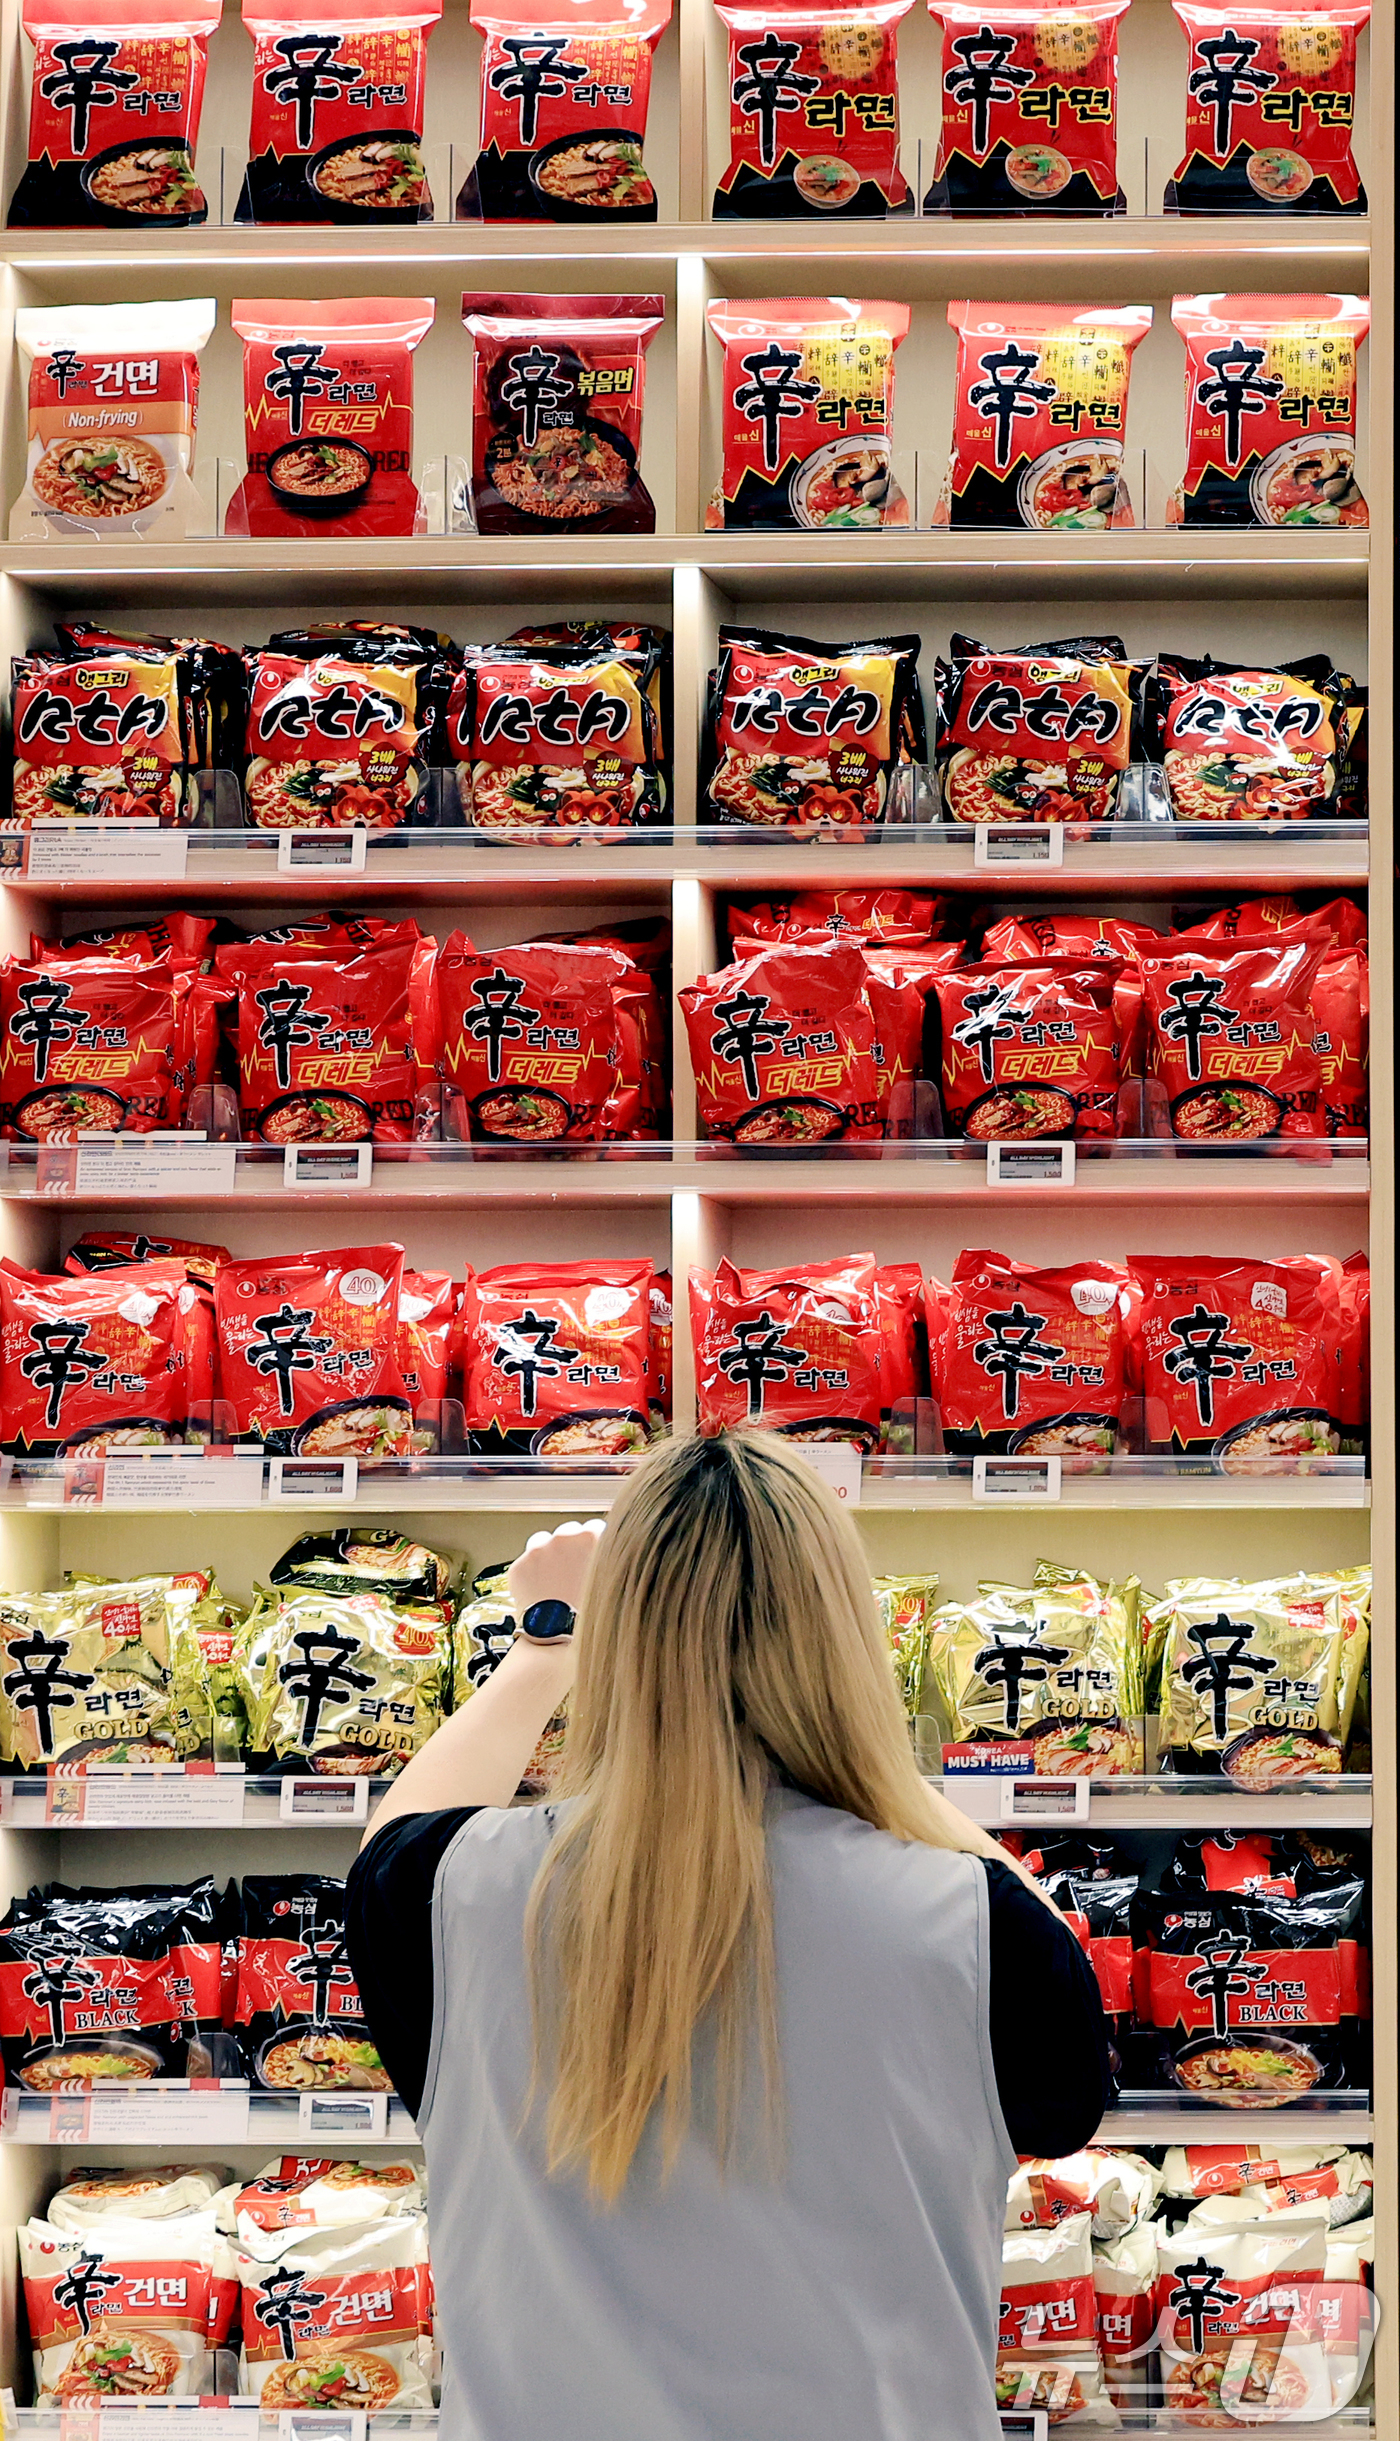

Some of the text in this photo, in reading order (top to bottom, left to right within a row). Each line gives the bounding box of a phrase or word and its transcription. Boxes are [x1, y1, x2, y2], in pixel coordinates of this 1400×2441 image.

[40, 35, 140, 155] 辛
[123, 90, 182, 116] 라면
[263, 32, 365, 149] 辛
[347, 83, 407, 109] 라면
[489, 32, 590, 146] 辛
[571, 83, 632, 108] 라면
[731, 31, 822, 167] 辛
[943, 24, 1036, 155] 辛
[1188, 27, 1279, 157] 辛
[804, 90, 896, 137] 라면
[1018, 83, 1112, 128] 라면
[1260, 87, 1353, 132] 라면
[46, 346, 86, 399] 辛
[90, 360, 159, 397] 건면
[265, 338, 341, 435] 辛
[577, 367, 634, 396] 볶음면
[328, 381, 377, 404] 라면
[501, 345, 574, 447] 辛
[734, 341, 821, 471] 辛
[968, 341, 1058, 468] 辛
[1197, 338, 1284, 466] 辛
[308, 410, 378, 434] 더레드
[542, 410, 574, 426] 라면
[816, 396, 888, 430] 라면
[1050, 400, 1122, 432] 라면
[1278, 394, 1351, 428] 라면
[76, 668, 130, 691] 앵그리
[133, 756, 159, 770] 3배
[369, 750, 396, 765] 3배
[594, 759, 622, 772] 3배
[839, 752, 867, 767] 3배
[1076, 760, 1104, 777] 3배
[9, 975, 91, 1083] 辛
[75, 1026, 129, 1050] 라면
[255, 978, 332, 1089] 辛
[463, 967, 541, 1082] 辛
[526, 1025, 580, 1050] 라면
[1020, 1021, 1077, 1046] 라면
[1159, 971, 1239, 1080] 辛
[1227, 1021, 1281, 1047] 라면
[317, 1027, 373, 1053] 라면
[711, 990, 793, 1101] 辛
[780, 1030, 838, 1059] 라면
[52, 1056, 133, 1082] 더레드
[298, 1058, 374, 1088] 더레드
[506, 1057, 583, 1083] 더레드
[766, 1061, 843, 1096] 더레드
[1000, 1052, 1080, 1080] 더레드
[1207, 1051, 1287, 1079] 더레드
[955, 1322, 986, 1349] 울리는
[21, 1318, 110, 1429] 辛
[245, 1302, 333, 1416] 辛
[322, 1347, 376, 1375] 라면
[491, 1308, 581, 1418] 辛
[718, 1311, 809, 1425] 辛
[973, 1301, 1066, 1419] 辛
[1164, 1303, 1254, 1427] 辛
[1242, 1359, 1297, 1385] 라면
[92, 1371, 148, 1394] 라면
[567, 1364, 622, 1387] 라면
[794, 1368, 850, 1391] 라면
[1050, 1363, 1105, 1386] 라면
[278, 1624, 378, 1749] 辛
[1056, 1669, 1113, 1692] 라면
[1181, 1613, 1277, 1742] 辛
[1264, 1678, 1321, 1703] 라면
[4, 1630, 95, 1755] 辛
[84, 1689, 144, 1715] 라면
[358, 1697, 415, 1725] 라면
[1042, 1698, 1115, 1720] GOLD
[1249, 1705, 1319, 1731] GOLD
[74, 1718, 149, 1740] GOLD
[340, 1723, 413, 1751] GOLD
[948, 1754, 1030, 1769] MUST HAVE
[1184, 1916, 1212, 1928] 농심
[22, 1932, 103, 2047] 辛
[90, 1986, 138, 2009] 라면
[1185, 1929, 1269, 2040] 辛
[1254, 1981, 1307, 2002] 라면
[74, 2009, 141, 2030] BLACK
[1239, 2005, 1308, 2023] BLACK
[1239, 2161, 1255, 2184] 辛
[1287, 2188, 1302, 2207] 辛
[278, 2205, 293, 2227] 辛
[53, 2249, 122, 2336] 辛
[123, 2277, 187, 2308] 건면
[1171, 2256, 1241, 2356] 辛
[1241, 2288, 1301, 2324] 건면
[255, 2265, 327, 2363] 辛
[331, 2289, 394, 2326] 건면
[1015, 2297, 1078, 2334] 건면
[1103, 2313, 1133, 2345] 면
[1207, 2321, 1240, 2335] 라면
